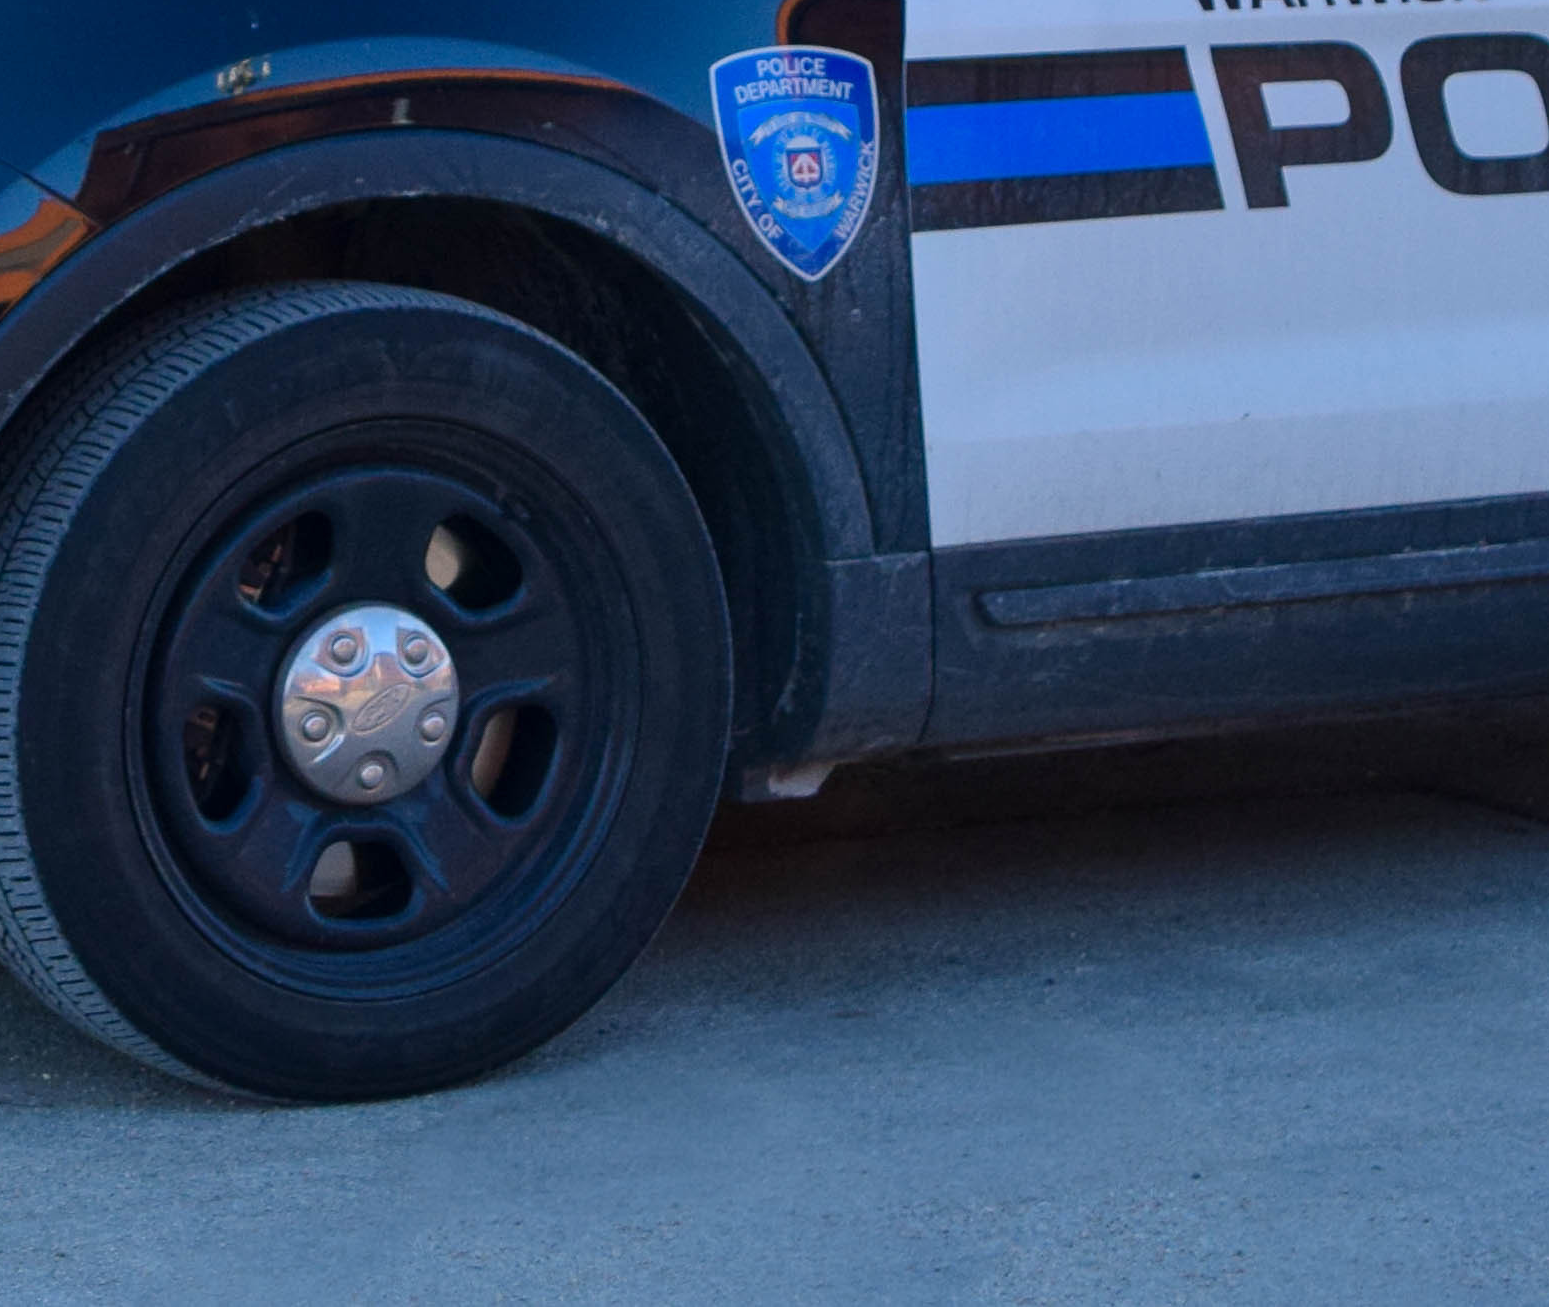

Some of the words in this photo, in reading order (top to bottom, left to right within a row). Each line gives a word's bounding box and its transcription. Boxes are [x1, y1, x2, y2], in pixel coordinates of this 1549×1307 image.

[734, 77, 854, 105] DEPARTMENT
[756, 57, 827, 78] POLICE
[732, 158, 763, 208] CITY
[758, 213, 784, 240] OF
[833, 140, 875, 241] WARWICK
